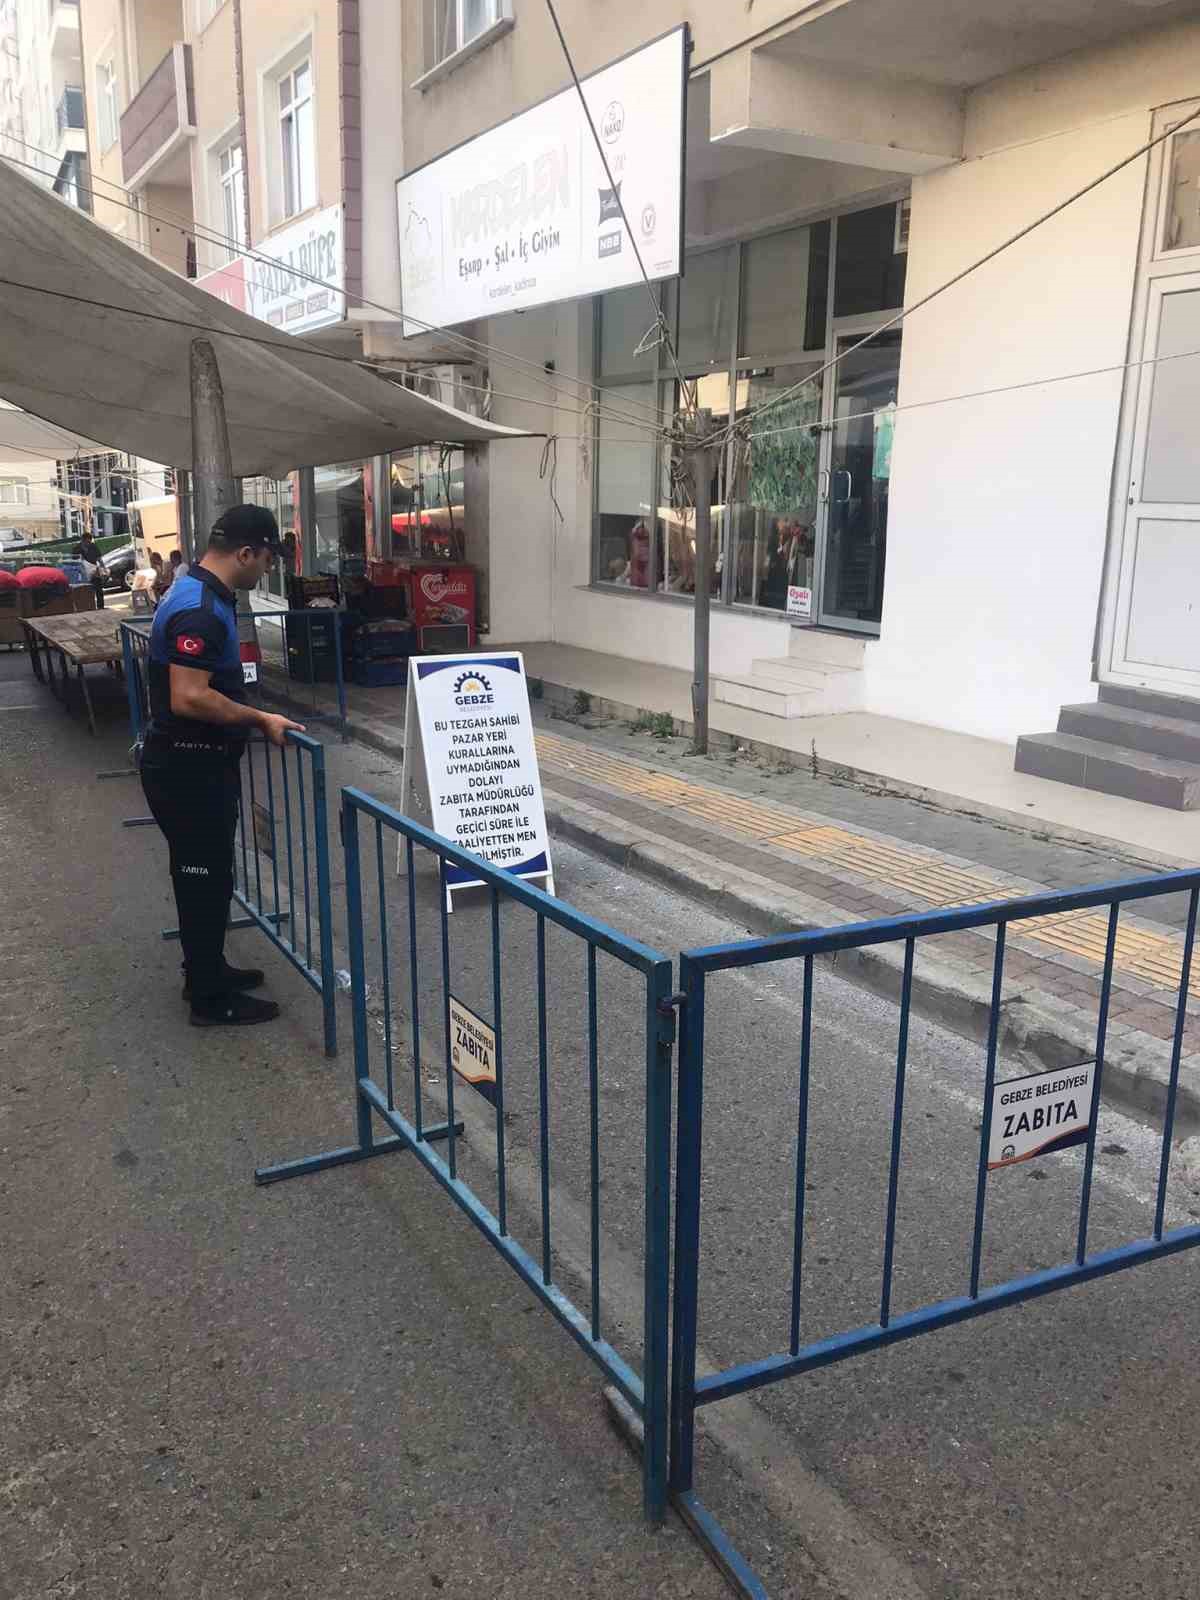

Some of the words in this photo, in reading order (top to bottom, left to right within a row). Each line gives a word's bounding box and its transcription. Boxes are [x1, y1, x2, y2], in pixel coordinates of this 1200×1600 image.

[455, 694, 494, 705] GEBZE
[434, 721, 448, 731] BU
[450, 718, 487, 729] TEZGAH
[489, 713, 520, 726] SAHİBİ
[452, 733, 484, 744] PAZAR
[486, 730, 506, 741] YERİ
[448, 745, 515, 759] KURALLARINA
[446, 759, 520, 775] UYMADIĞINDAN
[468, 775, 503, 787] DOLAYI
[440, 793, 474, 805] ZABITA
[476, 784, 534, 801] MÜDÜRLÜĞÜ
[459, 803, 520, 818] TARAFINDAN
[456, 822, 487, 835] GEÇİCİ
[490, 818, 513, 830] SÜRE
[516, 815, 529, 827] İLE
[453, 832, 514, 848] AALİYETTEN
[517, 831, 536, 841] MEN
[475, 846, 524, 861] İLMİŞTİR.
[456, 1026, 490, 1071] ZABITA
[1001, 1088, 1033, 1105] GEBZE
[1036, 1072, 1088, 1096] BELEDİYESİ
[1003, 1099, 1078, 1138] ZABITA
